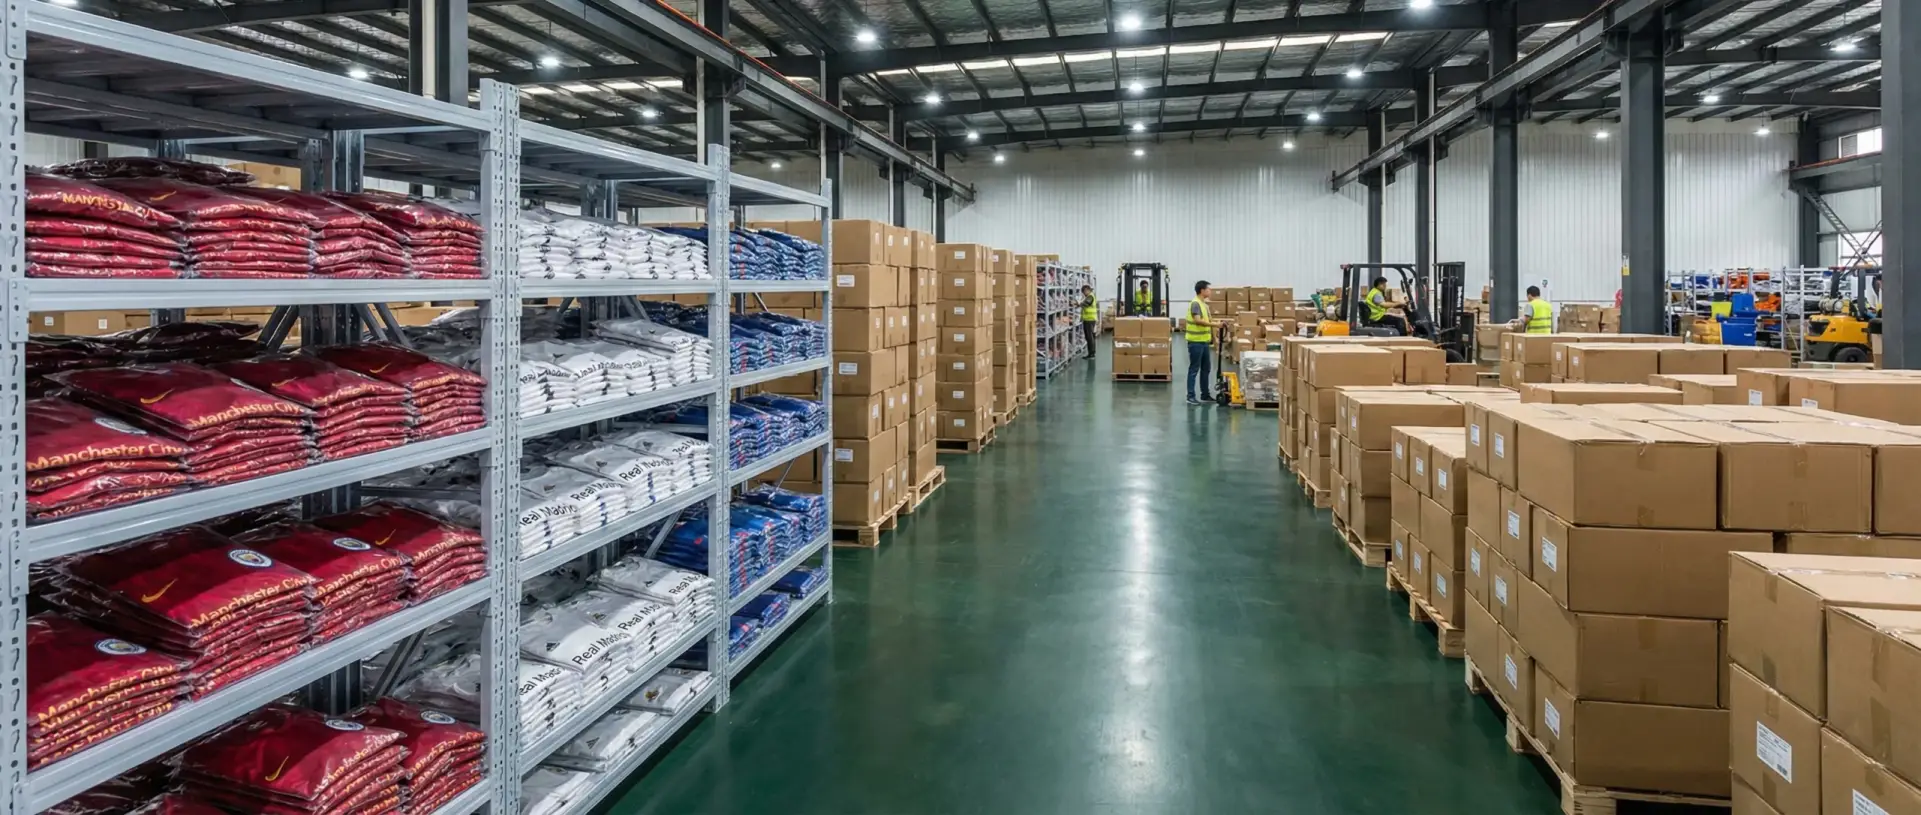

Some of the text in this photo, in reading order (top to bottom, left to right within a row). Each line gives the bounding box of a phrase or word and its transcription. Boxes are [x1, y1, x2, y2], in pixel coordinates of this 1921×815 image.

[27, 443, 145, 472] Manchester
[619, 463, 644, 481] Real
[570, 486, 597, 501] Real
[191, 583, 281, 628] Manchester
[618, 613, 644, 631] Real
[572, 643, 601, 665] Real
